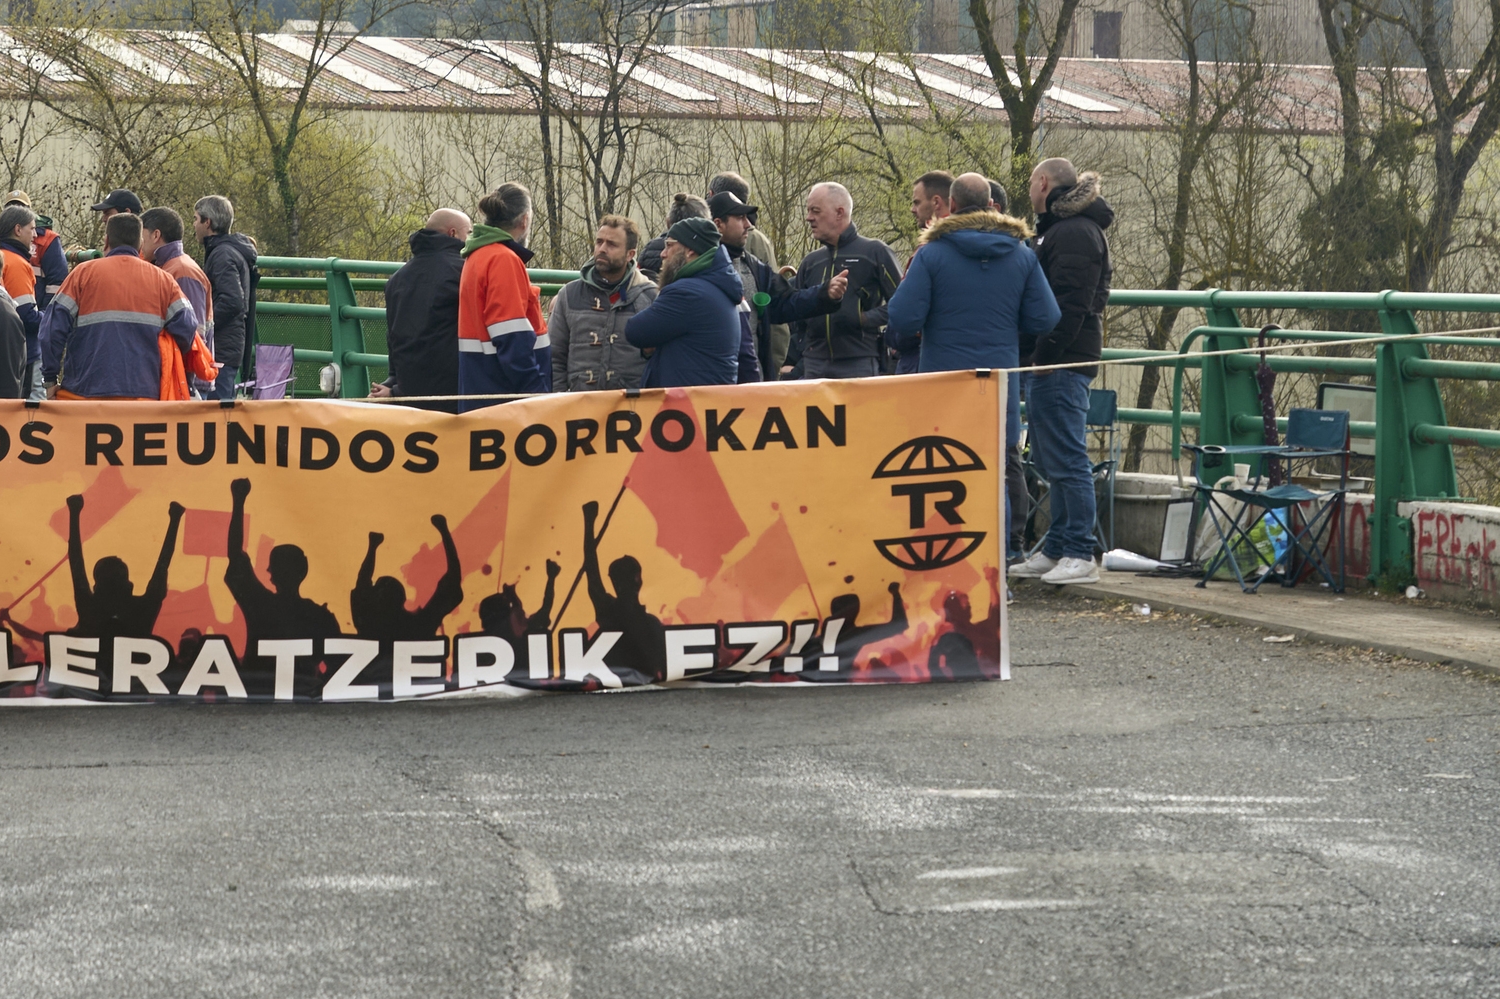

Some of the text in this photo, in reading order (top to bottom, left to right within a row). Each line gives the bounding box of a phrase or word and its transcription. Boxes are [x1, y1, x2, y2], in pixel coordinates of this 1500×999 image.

[84, 421, 440, 474] REUNIDOS
[468, 404, 848, 472] BORROKAN
[891, 480, 968, 530] TR
[664, 617, 846, 682] EZ!!
